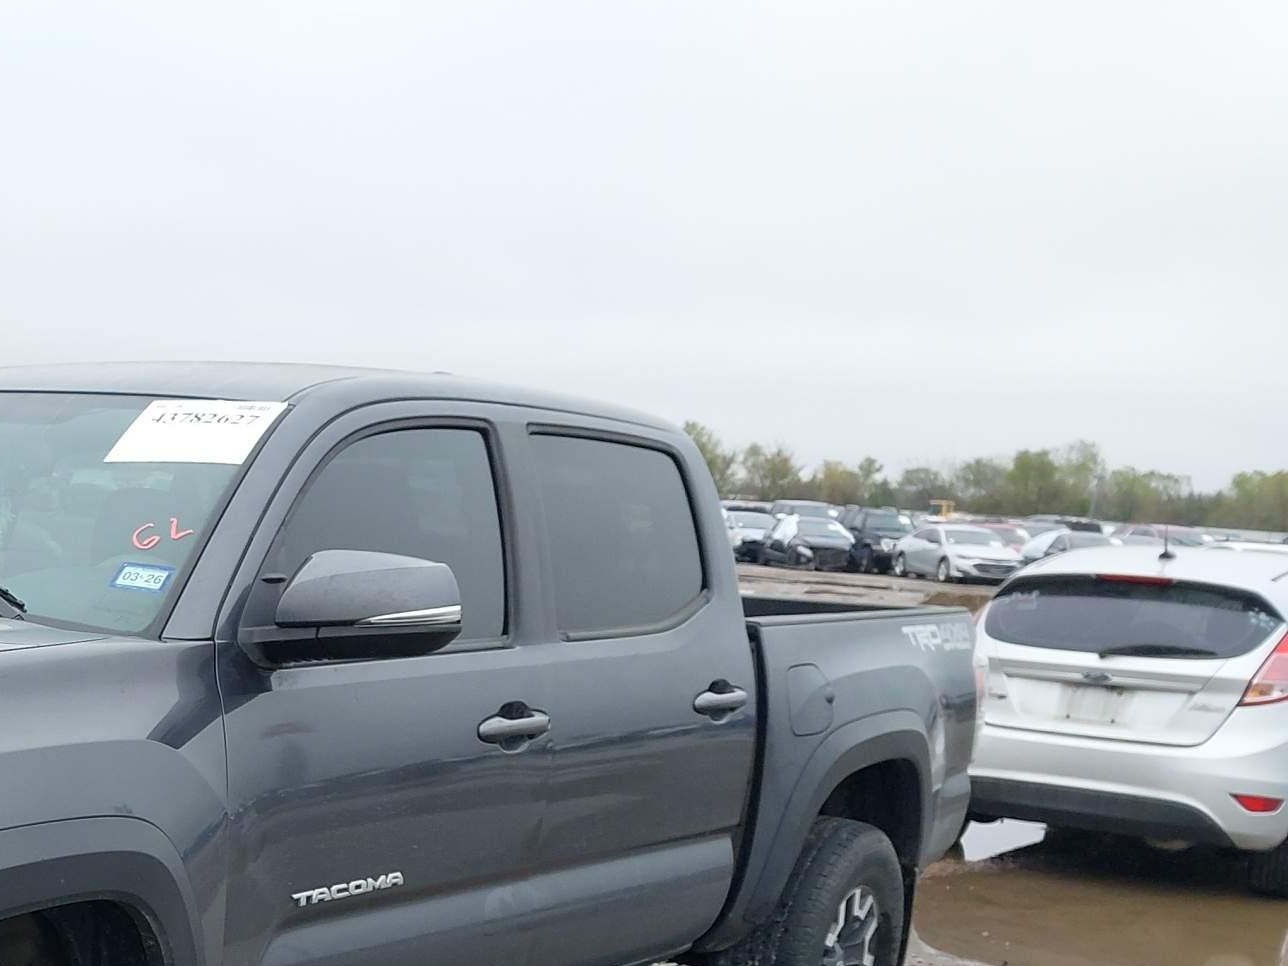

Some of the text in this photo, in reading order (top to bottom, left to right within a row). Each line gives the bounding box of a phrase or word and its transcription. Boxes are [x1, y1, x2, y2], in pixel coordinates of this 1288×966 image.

[151, 412, 261, 425] 43782627
[122, 571, 164, 585] 03 26
[291, 871, 404, 907] TACOMA
